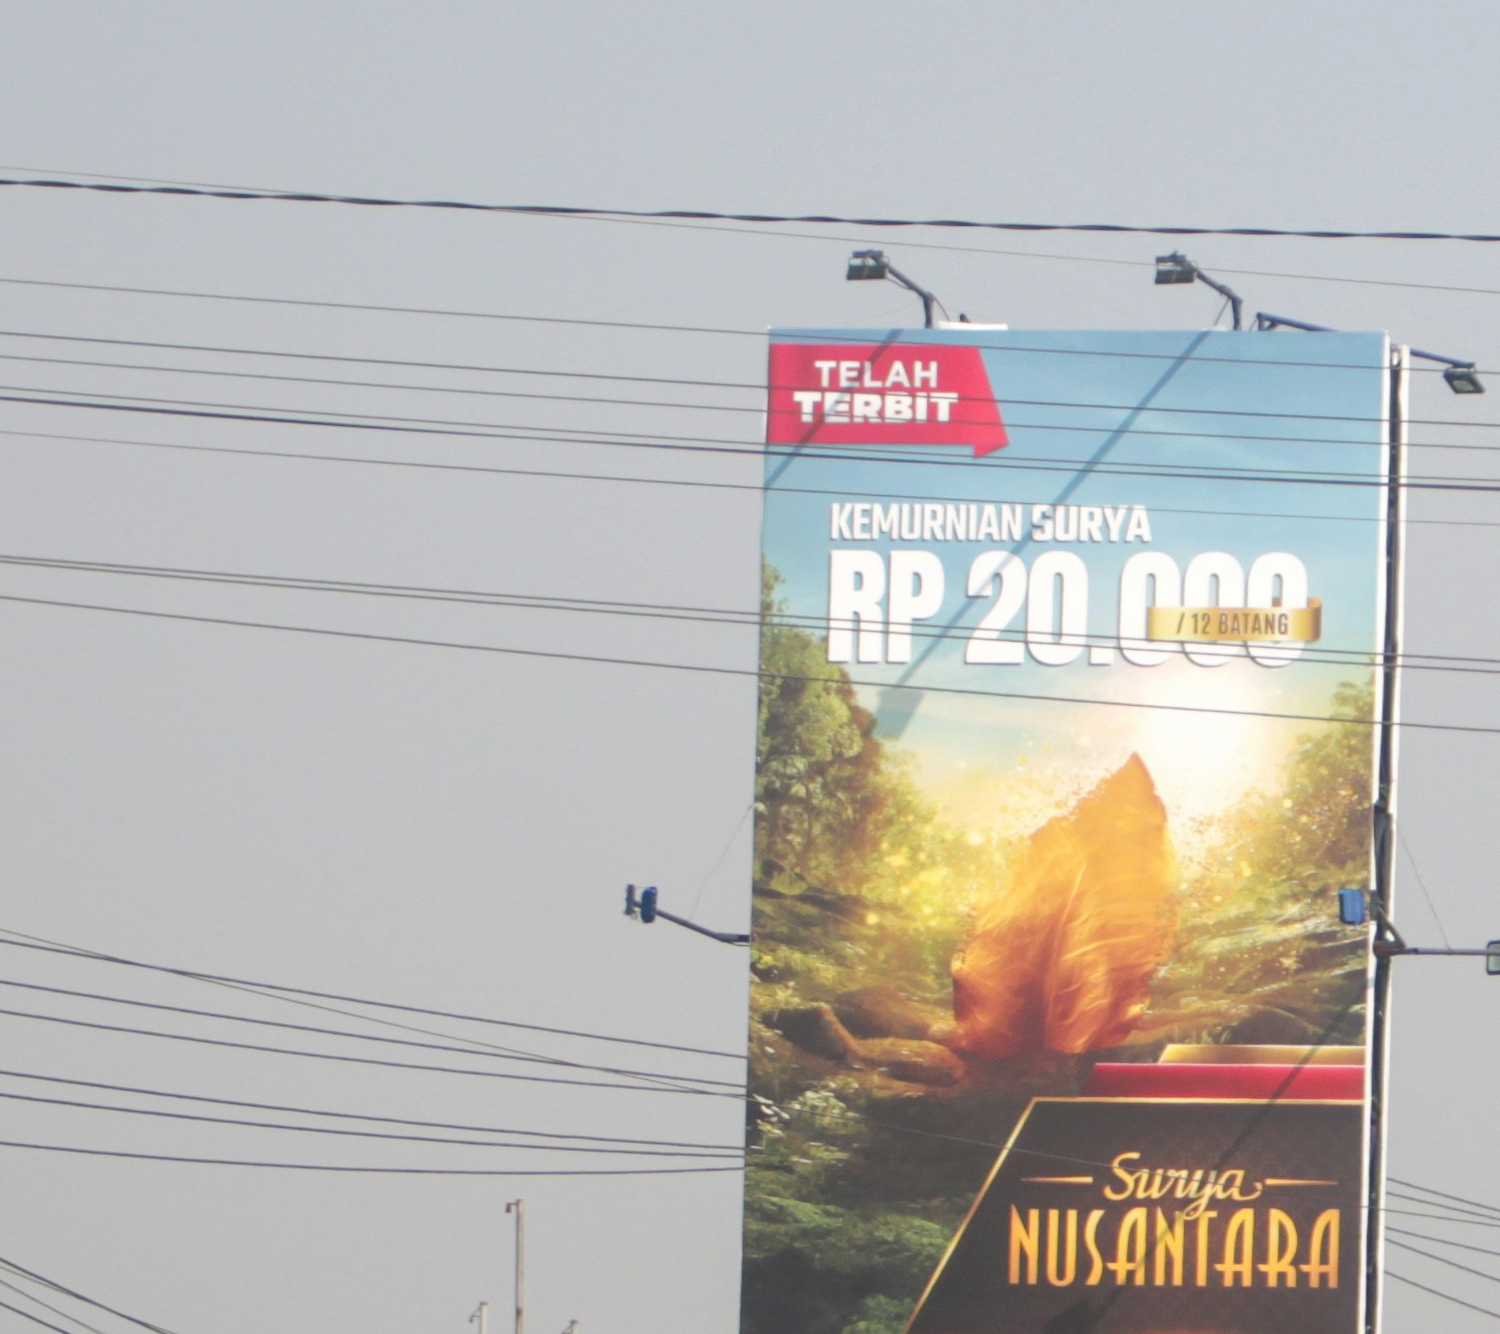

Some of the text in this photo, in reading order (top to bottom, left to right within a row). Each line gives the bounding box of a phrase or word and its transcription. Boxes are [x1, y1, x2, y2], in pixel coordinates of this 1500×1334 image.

[813, 360, 939, 389] TELAH
[792, 390, 959, 424] TERBIT
[829, 502, 1153, 544] KEMURNIAN SURYA
[826, 548, 1309, 668] RP 20.000
[1190, 612, 1212, 636] 12
[1218, 611, 1290, 637] BATANG
[1102, 1151, 1264, 1221] Surya
[1008, 1203, 1341, 1289] NUSANTARA
